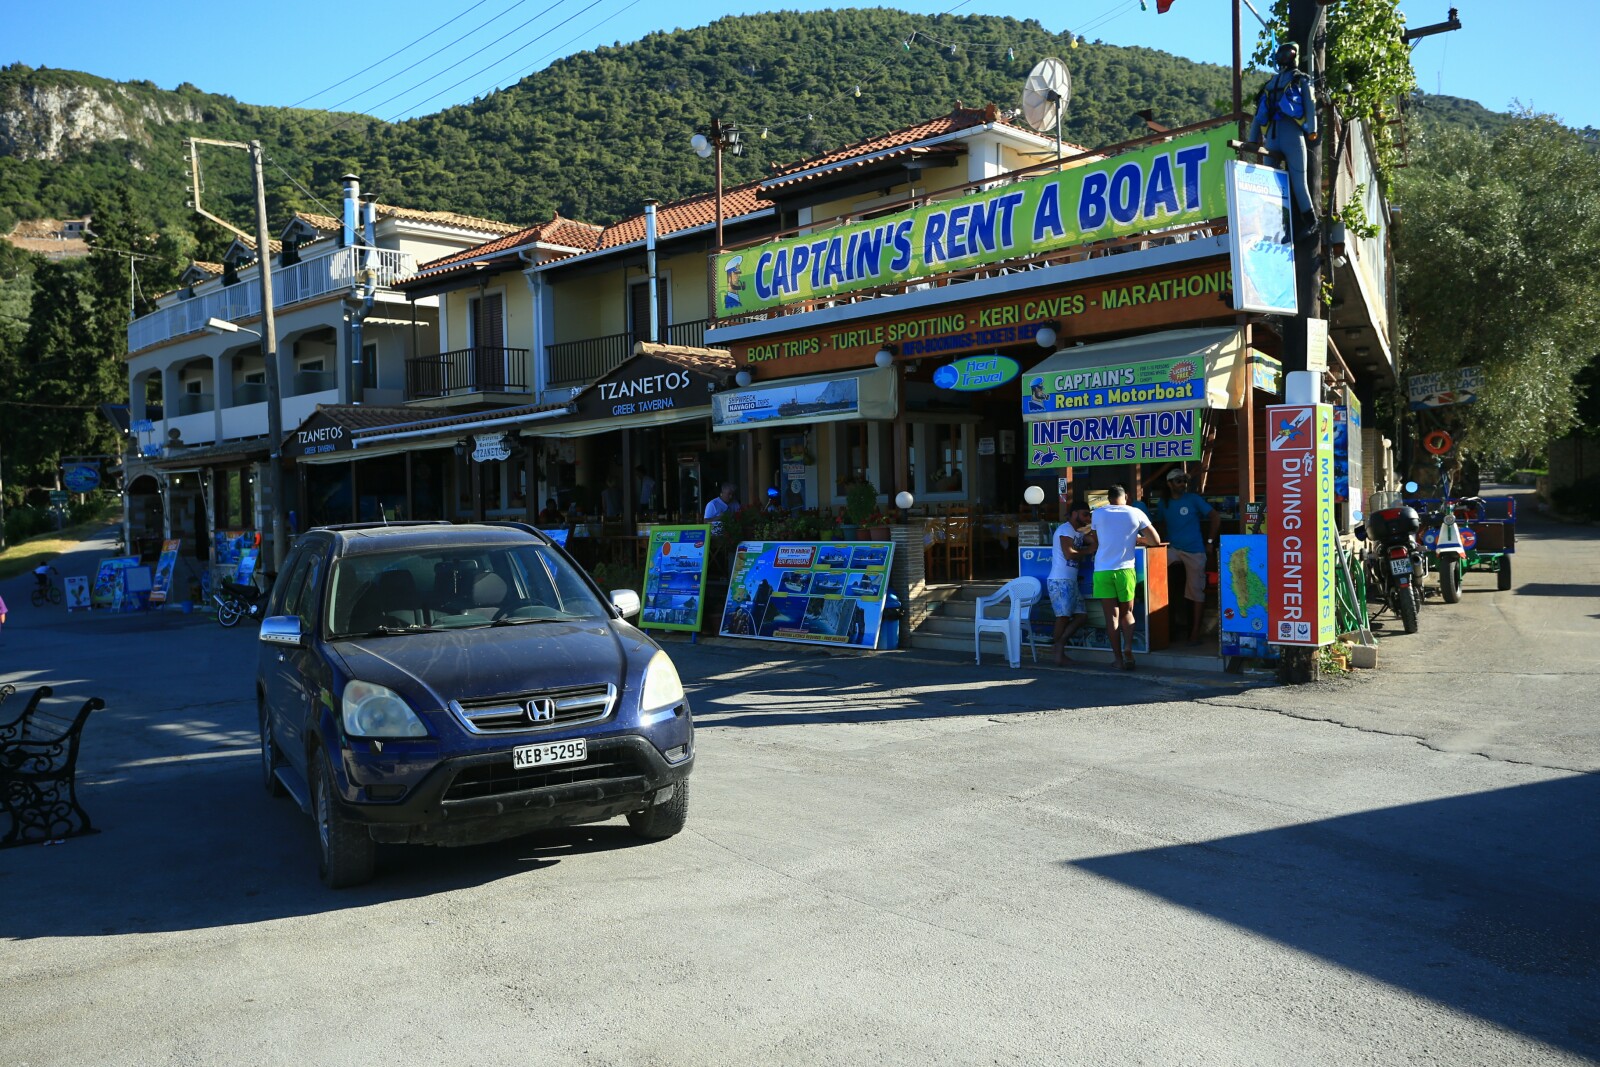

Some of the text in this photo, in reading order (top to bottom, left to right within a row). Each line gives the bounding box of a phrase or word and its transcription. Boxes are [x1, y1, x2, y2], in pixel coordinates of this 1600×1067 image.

[753, 142, 1210, 302] CAPTAIN'S RENT A BOAT
[748, 344, 780, 363] BOAT
[783, 337, 819, 358] TRIPS
[831, 327, 884, 351] TURTLE
[888, 313, 965, 341] SPOTTING
[979, 305, 1019, 329] KERI
[1023, 295, 1084, 321] CAVES
[598, 369, 690, 400] TZANETOS
[961, 370, 1003, 387] Travel
[1054, 368, 1135, 392] CAPTAIN'S
[1176, 371, 1190, 380] FREE
[612, 397, 674, 416] GREEK TAVERNA
[728, 395, 756, 405] SHIPWRECK
[729, 402, 755, 412] NAVAGIO
[1055, 382, 1193, 409] Rent a Motorboat
[297, 426, 343, 444] TZANETOS
[1032, 410, 1194, 446] INFORMATION
[1063, 438, 1194, 463] TICKETS HERE
[1282, 458, 1302, 620] DIVING CENTER
[1321, 458, 1330, 619] MOTORBOATS
